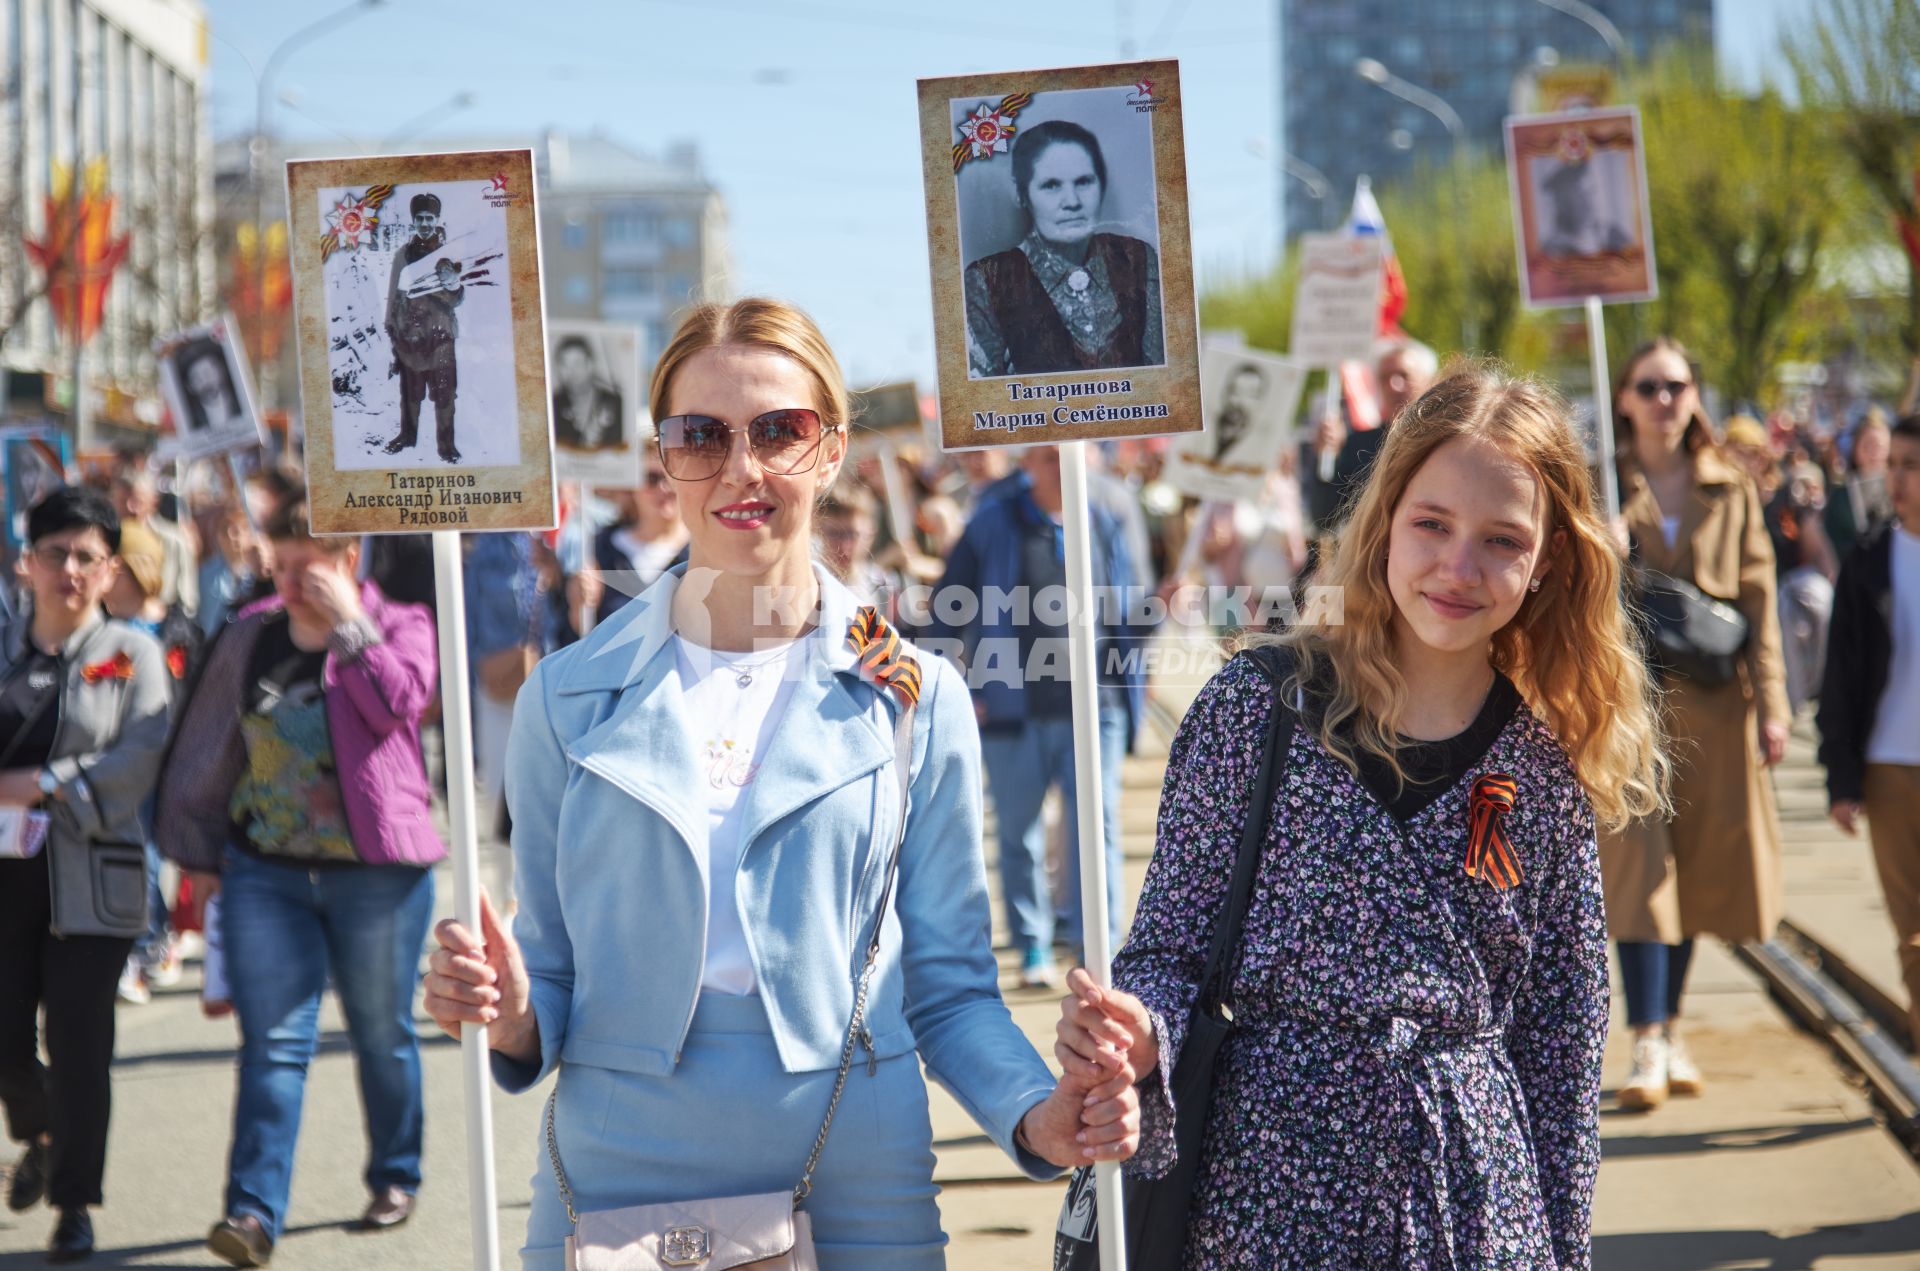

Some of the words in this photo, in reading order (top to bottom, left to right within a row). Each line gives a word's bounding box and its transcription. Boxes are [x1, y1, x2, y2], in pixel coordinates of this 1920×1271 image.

[1007, 379, 1132, 401] Татаринова
[974, 410, 1047, 432] Мария
[1052, 403, 1169, 425] Семёновна
[387, 473, 476, 492] Татаринов
[344, 490, 433, 510] Александр
[439, 489, 522, 506] Иванович
[399, 507, 468, 526] Рядовой
